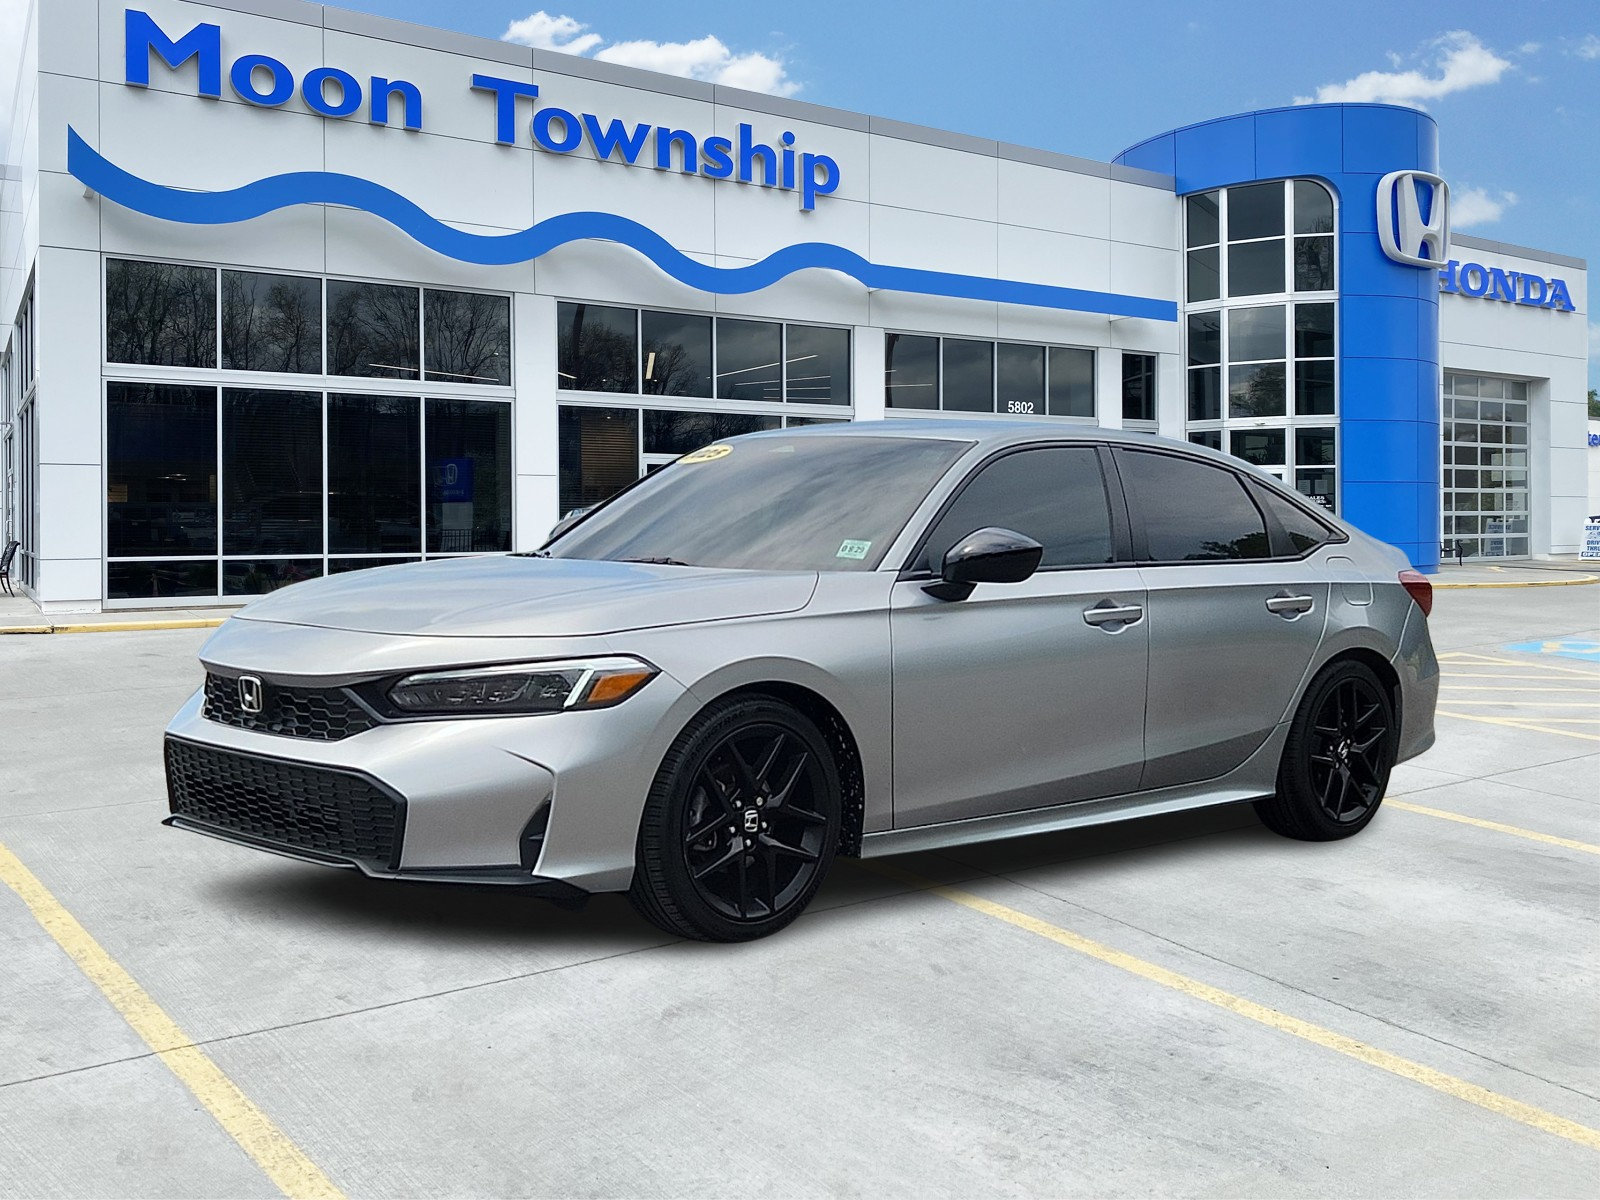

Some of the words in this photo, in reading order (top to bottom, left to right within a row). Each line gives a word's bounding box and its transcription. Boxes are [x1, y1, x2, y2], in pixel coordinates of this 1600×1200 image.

[125, 8, 423, 133] Moon
[470, 73, 841, 213] Township
[1007, 400, 1034, 414] 5802
